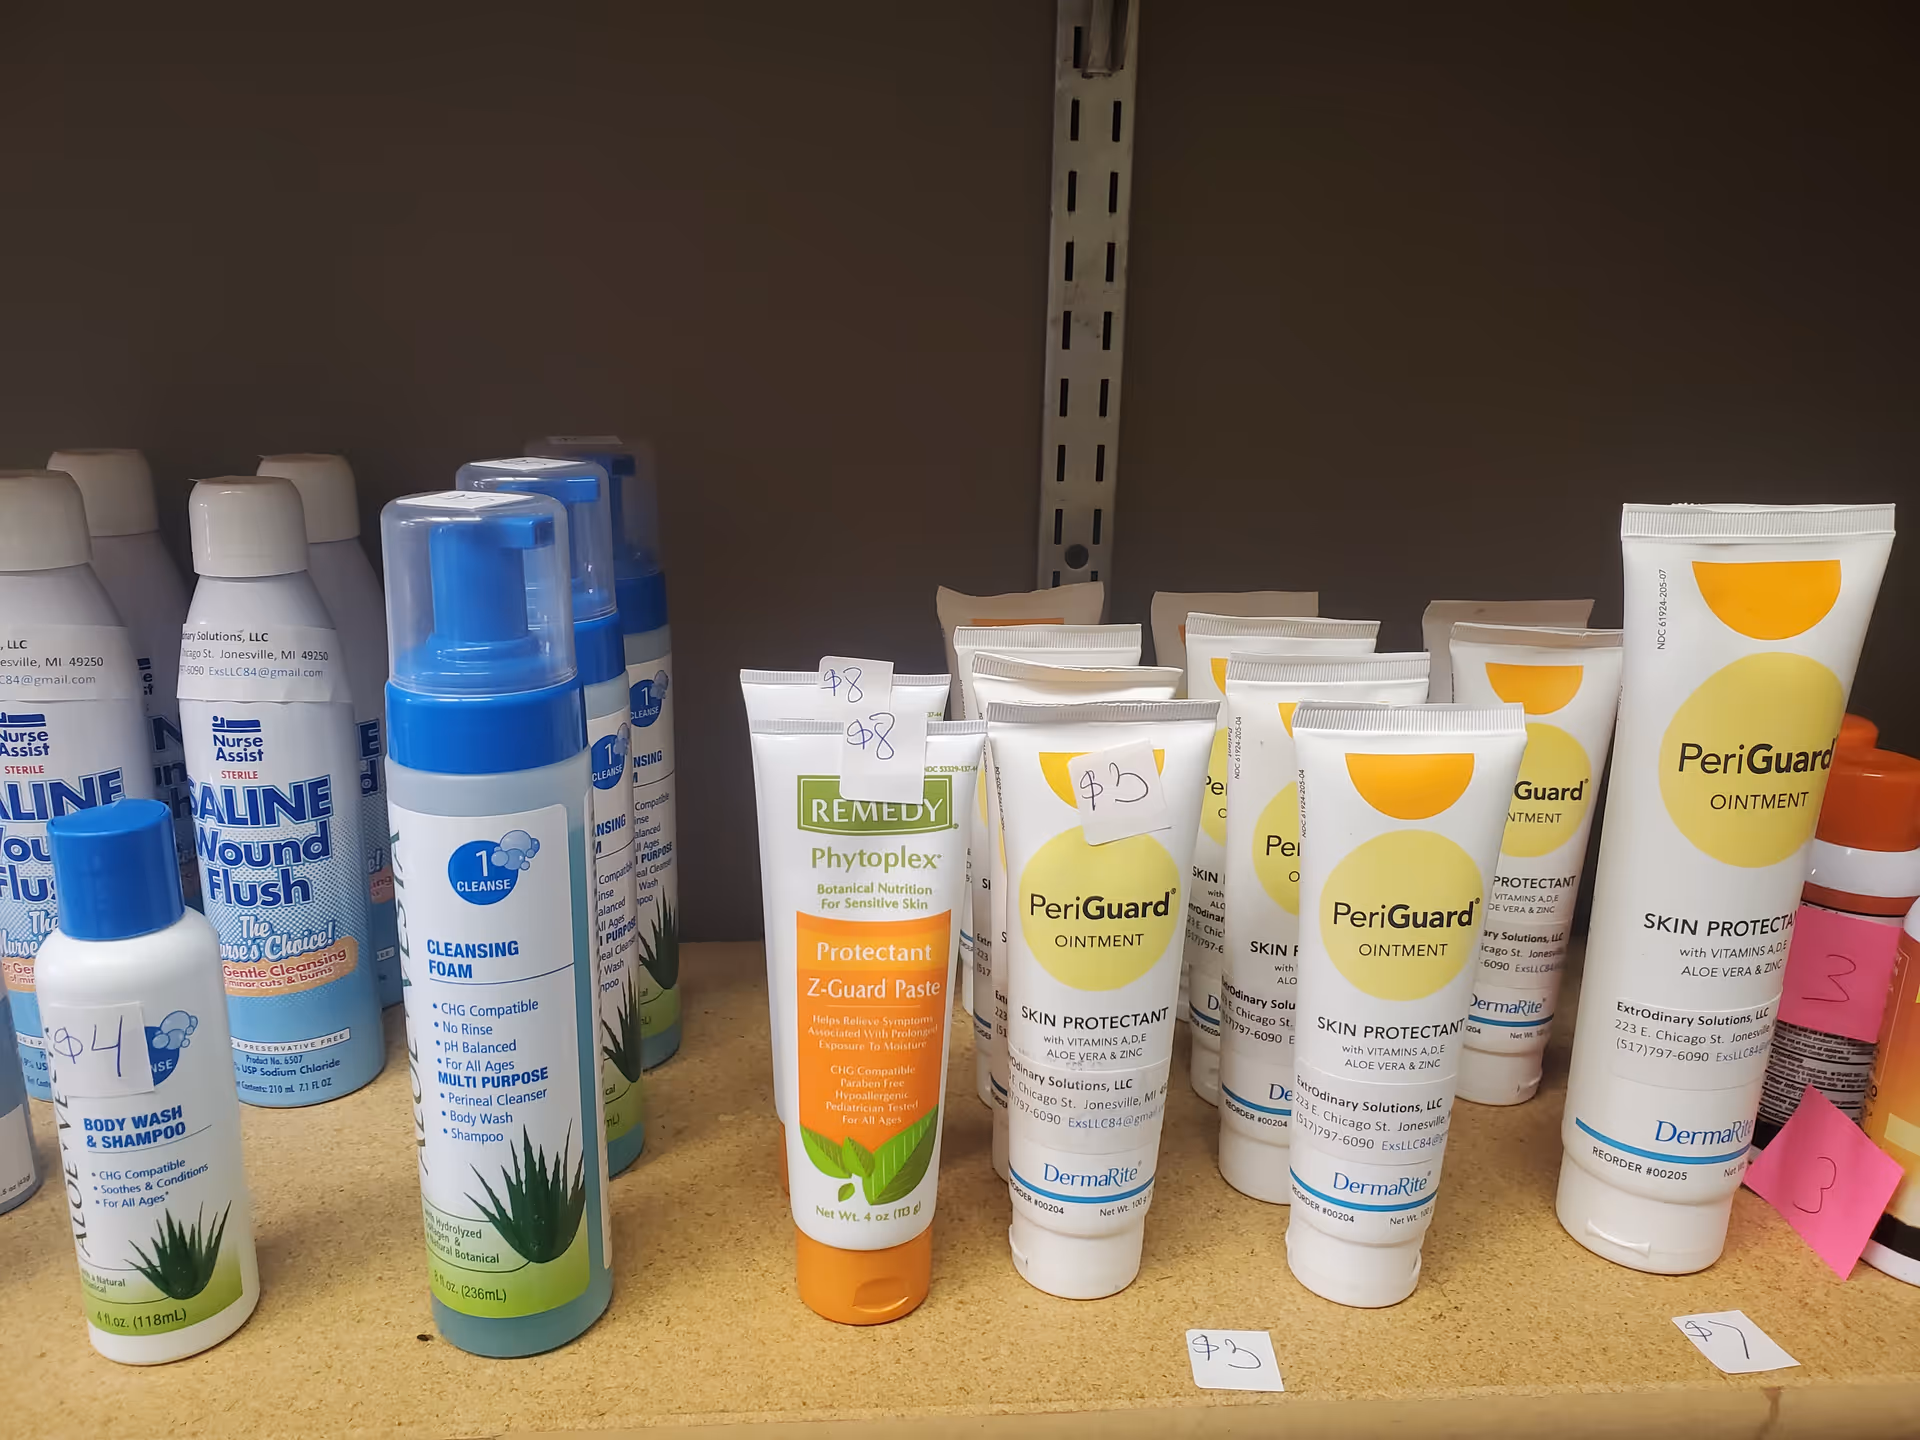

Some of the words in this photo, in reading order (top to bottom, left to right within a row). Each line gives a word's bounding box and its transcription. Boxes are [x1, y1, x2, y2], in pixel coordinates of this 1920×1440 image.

[1658, 569, 1667, 628] 61924-205-07
[1657, 628, 1666, 650] NDC
[69, 657, 104, 667] 49250
[220, 649, 277, 661] Jonesville,
[301, 651, 329, 661] 49250
[208, 666, 323, 679] ExsLLC84@gmail.com
[820, 667, 864, 703] $8
[213, 735, 264, 748] Nurse
[846, 712, 896, 760] $8
[1234, 716, 1242, 766] 61924-205-04
[216, 747, 264, 762] Assist
[1678, 737, 1834, 775] PeriGuard
[4, 765, 45, 775] STERILE
[221, 770, 259, 780] STERILE
[1080, 762, 1149, 811] $3
[1514, 781, 1583, 801] Guard
[811, 798, 943, 823] REMEDY
[1710, 792, 1809, 810] OINTMENT
[811, 846, 938, 873] Phytoplex
[1192, 866, 1219, 883] SKIN
[1493, 875, 1577, 889] PROTECTANT
[208, 864, 312, 907] Flush
[456, 879, 511, 892] CLEANSE
[816, 882, 875, 895] Botanical
[877, 883, 933, 895] Nutrition
[821, 898, 840, 909] For
[844, 897, 899, 909] Sensitive
[902, 898, 928, 909] Skin
[1030, 891, 1170, 921] PeriGuard
[1333, 900, 1474, 929] PeriGuard
[1643, 912, 1699, 936] SKIN
[1706, 910, 1798, 937] PROTECTA
[239, 914, 272, 938] The
[264, 921, 336, 962] Choice!
[1054, 933, 1145, 948] OINTMENT
[1500, 931, 1550, 943] Solutions,
[427, 939, 519, 958] CLEANSING
[816, 941, 932, 962] Protectant
[1250, 940, 1288, 957] SKIN
[1358, 943, 1448, 957] OINTMENT
[1679, 947, 1707, 958] with
[1710, 945, 1765, 959] VITAMINS
[270, 949, 347, 978] Cleansing
[428, 960, 473, 979] FOAM
[1681, 966, 1718, 978] ALOE
[1721, 967, 1752, 978] VERA
[1764, 958, 1783, 973] ZINC
[299, 966, 333, 982] burns
[1802, 954, 1857, 1002] 3
[807, 977, 886, 999] Z-Guard
[895, 979, 941, 998] Paste
[441, 1003, 466, 1016] CHG
[469, 1000, 539, 1019] Compatible
[1021, 1006, 1056, 1027] SKIN
[1063, 1006, 1169, 1031] PROTECTANT
[1236, 1005, 1276, 1027] Chicago
[1616, 1001, 1694, 1027] ExtrOdinary
[1697, 1012, 1753, 1026] Solutions,
[1755, 1007, 1769, 1020] LLC
[442, 1021, 458, 1034] No
[461, 1023, 493, 1035] Rinse
[812, 1014, 841, 1026] Helps
[843, 1015, 880, 1026] Relieve
[882, 1015, 934, 1027] Symptoms
[1317, 1016, 1357, 1037] SKIN
[1364, 1018, 1466, 1040] PROTECTANT
[807, 1026, 861, 1038] Associated
[864, 1028, 889, 1039] With
[891, 1025, 938, 1039] Prolonged
[1043, 1033, 1064, 1045] with
[1067, 1036, 1119, 1047] VITAMINS
[1120, 1033, 1147, 1045] A,D,E
[1615, 1018, 1637, 1034] 223
[1655, 1029, 1706, 1046] Chicago
[53, 1015, 123, 1078] $4
[244, 1041, 316, 1052] PRESERVATIVE
[320, 1033, 345, 1046] FREE
[444, 1041, 458, 1053] pH
[462, 1040, 517, 1053] Balanced
[818, 1041, 865, 1052] Exposure
[883, 1040, 928, 1051] Moisture
[1342, 1044, 1364, 1055] with
[1367, 1046, 1418, 1057] VITAMINS
[1420, 1044, 1445, 1056] A,D,E
[1616, 1037, 1709, 1062] (517)797-6090
[1046, 1048, 1076, 1060] ALOE
[1079, 1050, 1108, 1061] VERA
[1120, 1048, 1143, 1059] ZINC
[1345, 1058, 1375, 1070] ALOE
[1378, 1061, 1406, 1071] VERA
[1418, 1058, 1441, 1070] ZINC
[260, 1068, 296, 1077] Sodium
[299, 1058, 340, 1074] Chloride
[445, 1058, 463, 1071] For
[465, 1059, 481, 1072] All
[485, 1059, 515, 1074] Ages
[857, 1065, 916, 1077] Compatible
[438, 1072, 477, 1088] MULTI
[482, 1066, 549, 1088] PURPOSE
[840, 1078, 881, 1088] Paraben
[1048, 1075, 1111, 1092] Solutions,
[1114, 1078, 1133, 1090] LLC
[448, 1093, 493, 1107] Perineal
[496, 1087, 548, 1106] Cleanser
[835, 1090, 909, 1103] Hypoallergenic
[1018, 1080, 1058, 1106] Chicago
[1083, 1095, 1143, 1110] Jonesville,
[1296, 1074, 1359, 1111] ExtrOdinary
[1361, 1101, 1424, 1114] Solutions,
[1426, 1098, 1443, 1111] LLC
[825, 1101, 884, 1113] Pediatrician
[887, 1101, 919, 1112] Tested
[1225, 1098, 1255, 1122] REORDER
[1257, 1115, 1288, 1129] #00204
[84, 1117, 127, 1132] BODY
[131, 1105, 183, 1129] WASH
[450, 1111, 477, 1126] Body
[480, 1111, 513, 1125] Wash
[842, 1115, 859, 1125] For
[878, 1115, 902, 1127] Ages
[1323, 1108, 1371, 1132] Chicago
[86, 1135, 97, 1148] &
[102, 1122, 186, 1149] SHAMPOO
[451, 1128, 504, 1144] Shampoo
[1296, 1111, 1375, 1149] (517)797-6090
[1655, 1119, 1753, 1146] DermaRite
[125, 1158, 186, 1180] Compatible
[1592, 1146, 1643, 1174] REORDER
[1646, 1167, 1688, 1181] #00205
[101, 1184, 141, 1195] Soothes
[156, 1163, 209, 1189] Conditions
[1043, 1162, 1138, 1188] DermaRite
[1333, 1172, 1428, 1196] DermaRite
[1793, 1156, 1837, 1214] 3
[103, 1199, 119, 1209] For
[121, 1197, 136, 1208] All
[815, 1206, 835, 1219] Net
[1033, 1197, 1065, 1215] #00204
[1291, 1183, 1320, 1212] REORDER
[1321, 1207, 1355, 1223] #00204
[436, 1214, 483, 1239] Hydrolyzed
[455, 1247, 500, 1264] Botanical
[461, 1285, 507, 1303] (236mL)
[132, 1308, 187, 1330] (118mL)
[1685, 1320, 1750, 1360] $7
[1192, 1333, 1262, 1369] $3
